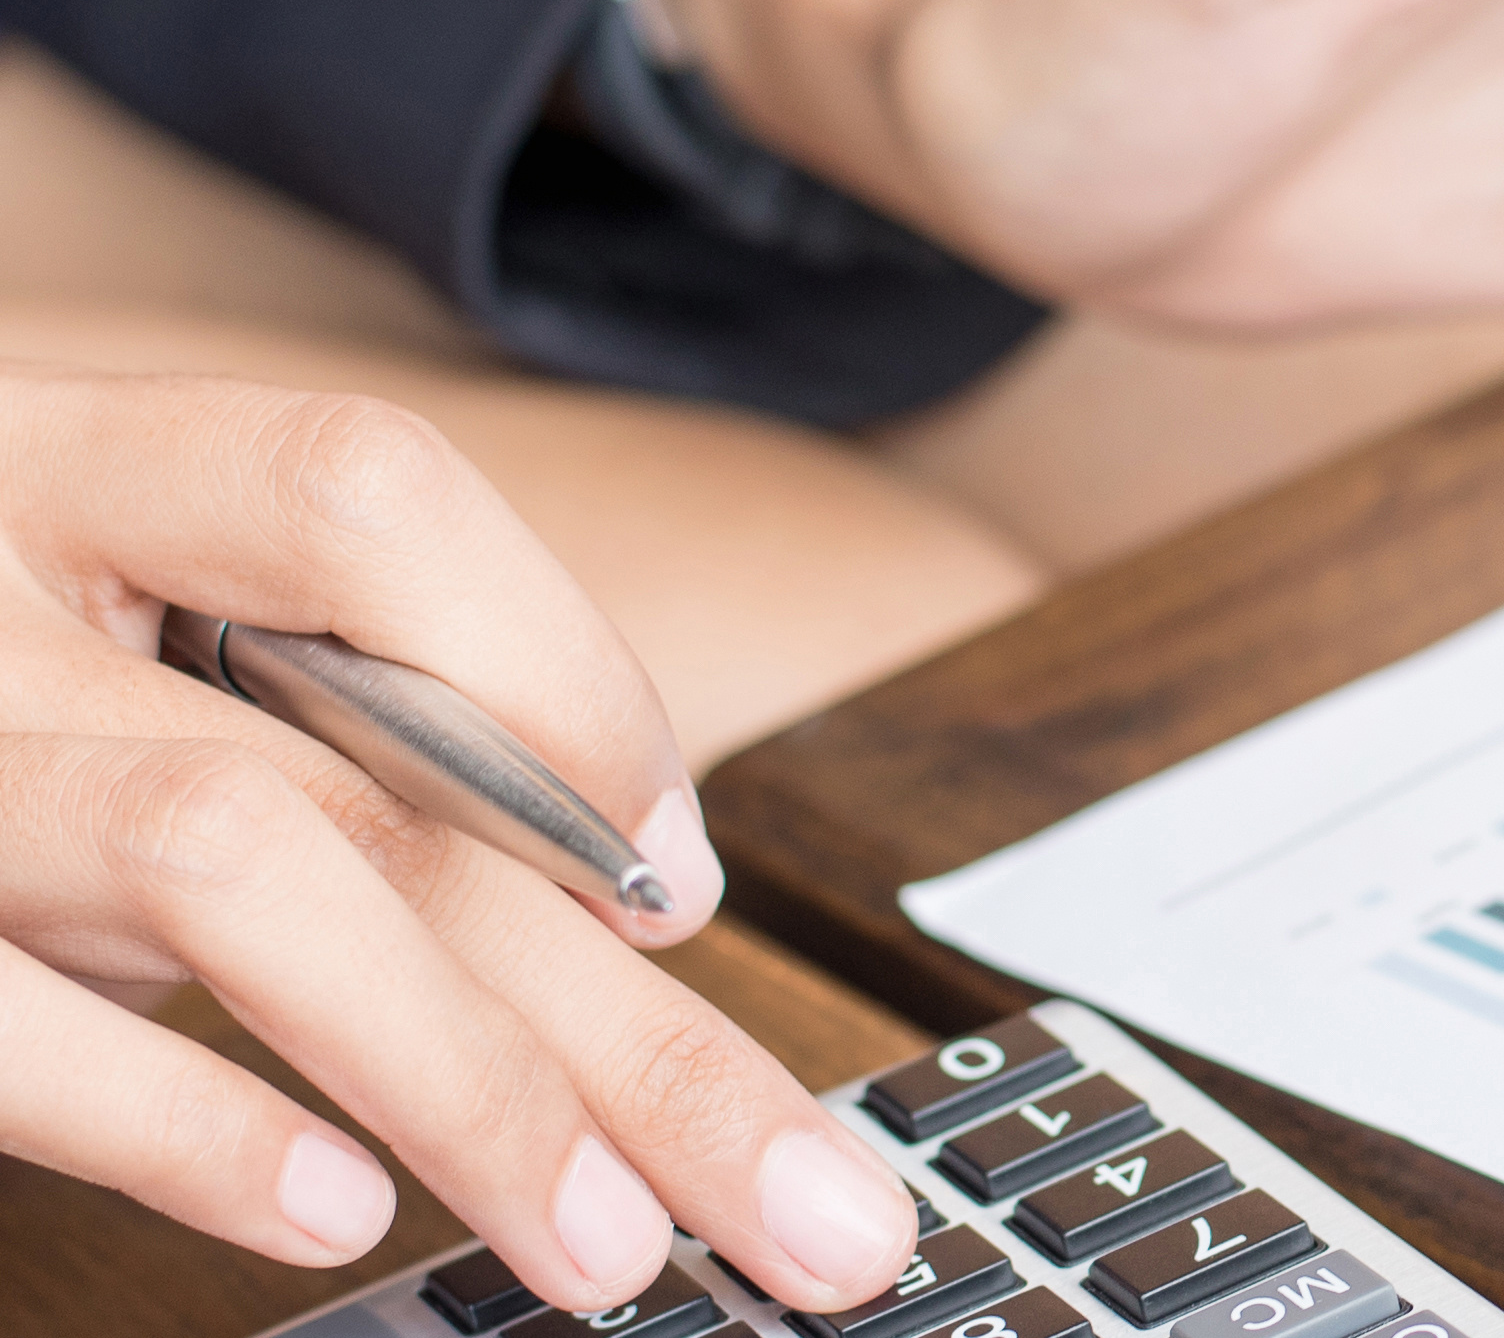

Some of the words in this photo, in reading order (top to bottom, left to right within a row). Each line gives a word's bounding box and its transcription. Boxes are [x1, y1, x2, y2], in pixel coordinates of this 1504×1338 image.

[939, 1038, 1004, 1080] 0
[1019, 1104, 1070, 1137] 1
[1092, 1153, 1149, 1199] 4
[1191, 1216, 1247, 1263] 7
[1230, 1266, 1351, 1332] MC
